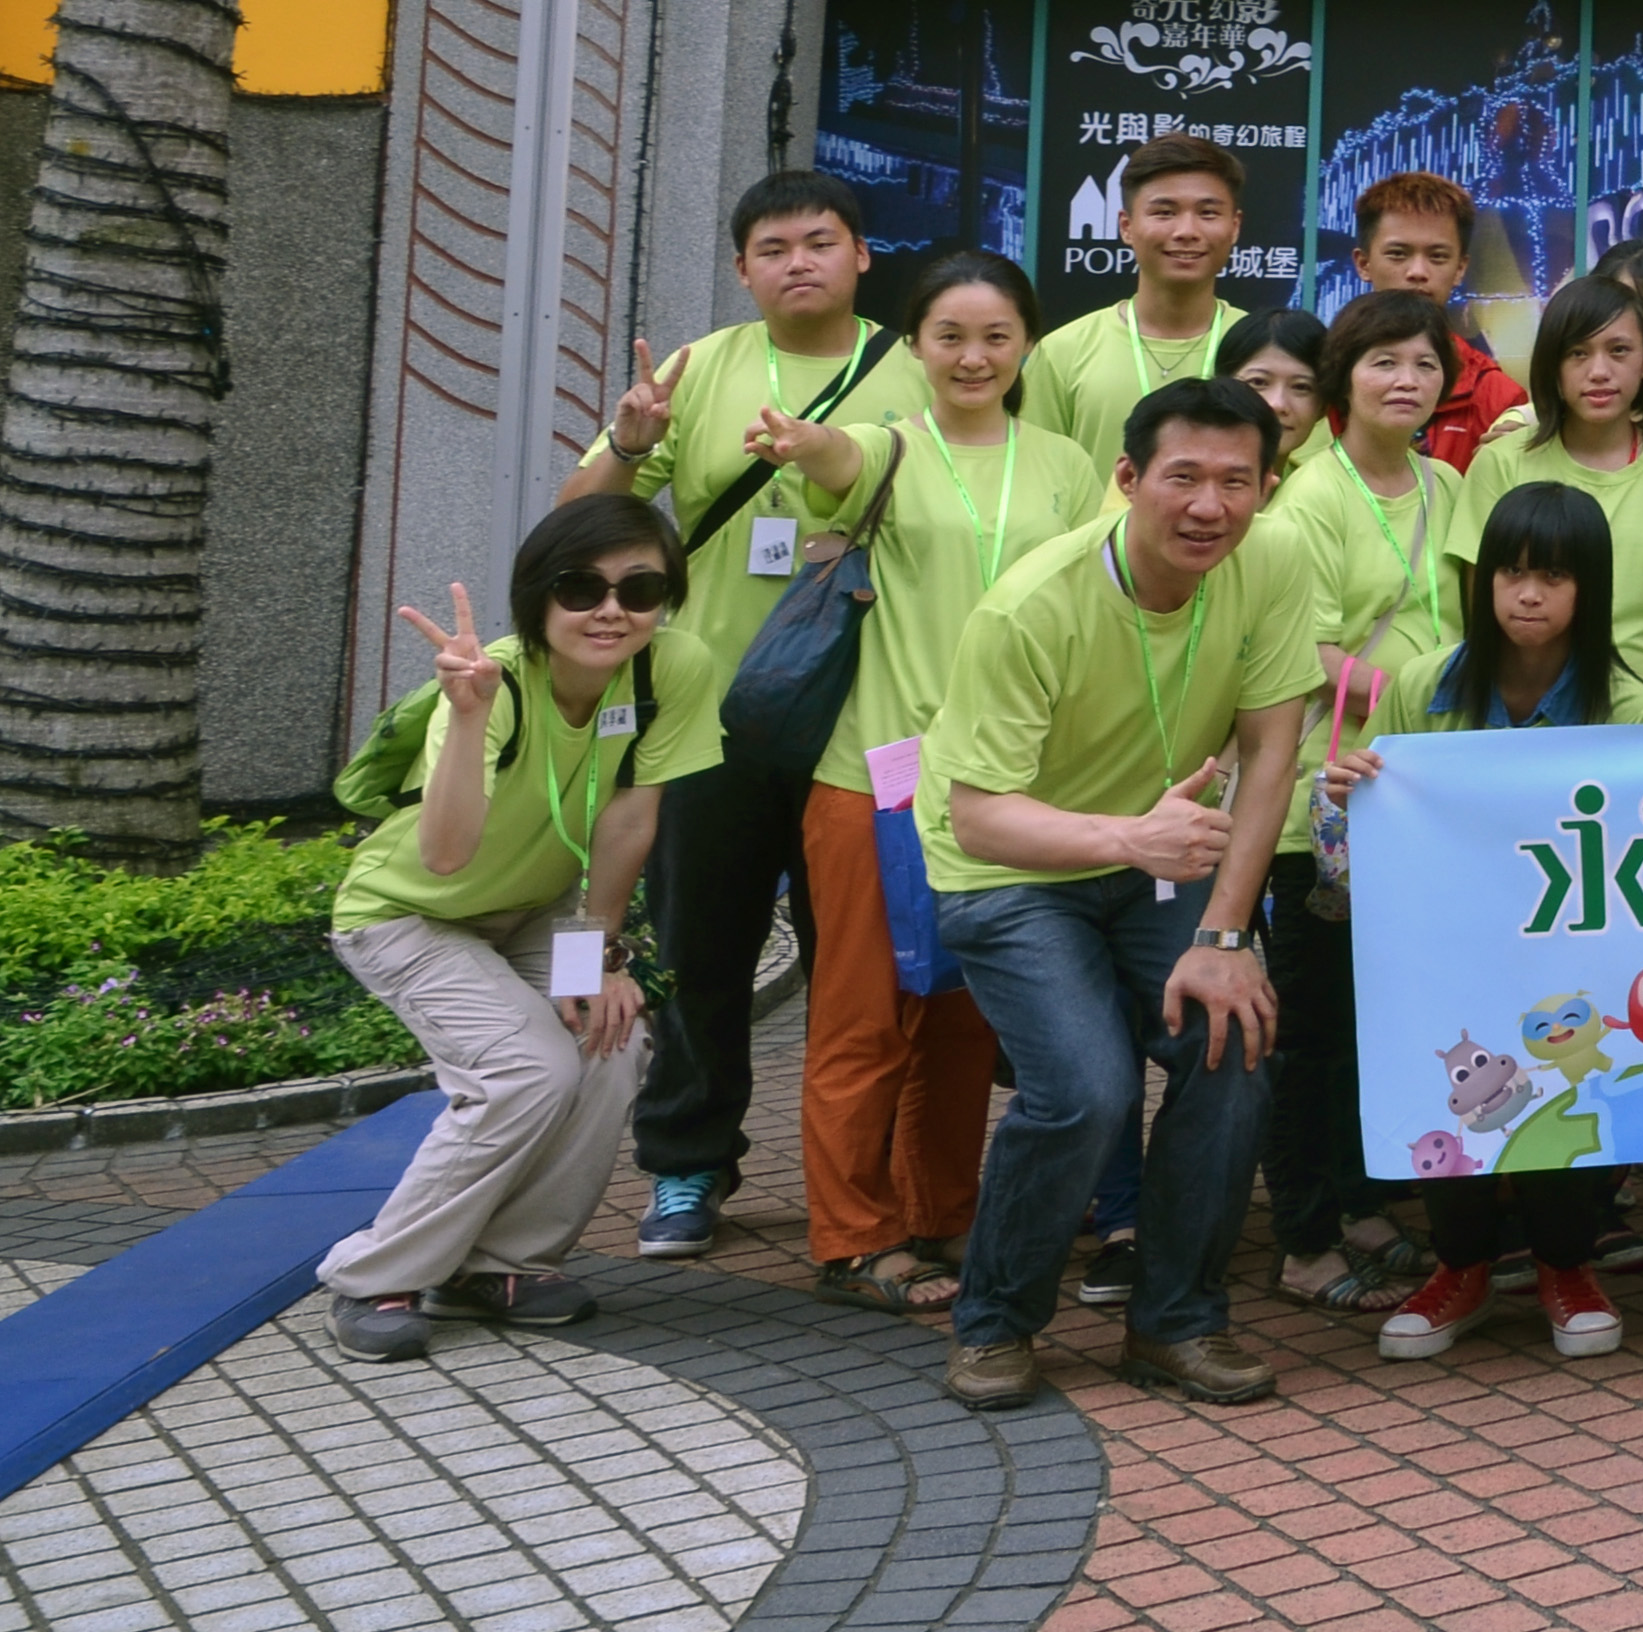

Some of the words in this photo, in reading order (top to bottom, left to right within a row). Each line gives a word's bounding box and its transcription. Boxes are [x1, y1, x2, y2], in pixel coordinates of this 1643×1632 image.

[1161, 22, 1247, 49] 嘉年華
[1064, 247, 1139, 274] POP
[1216, 246, 1299, 279] 城堡
